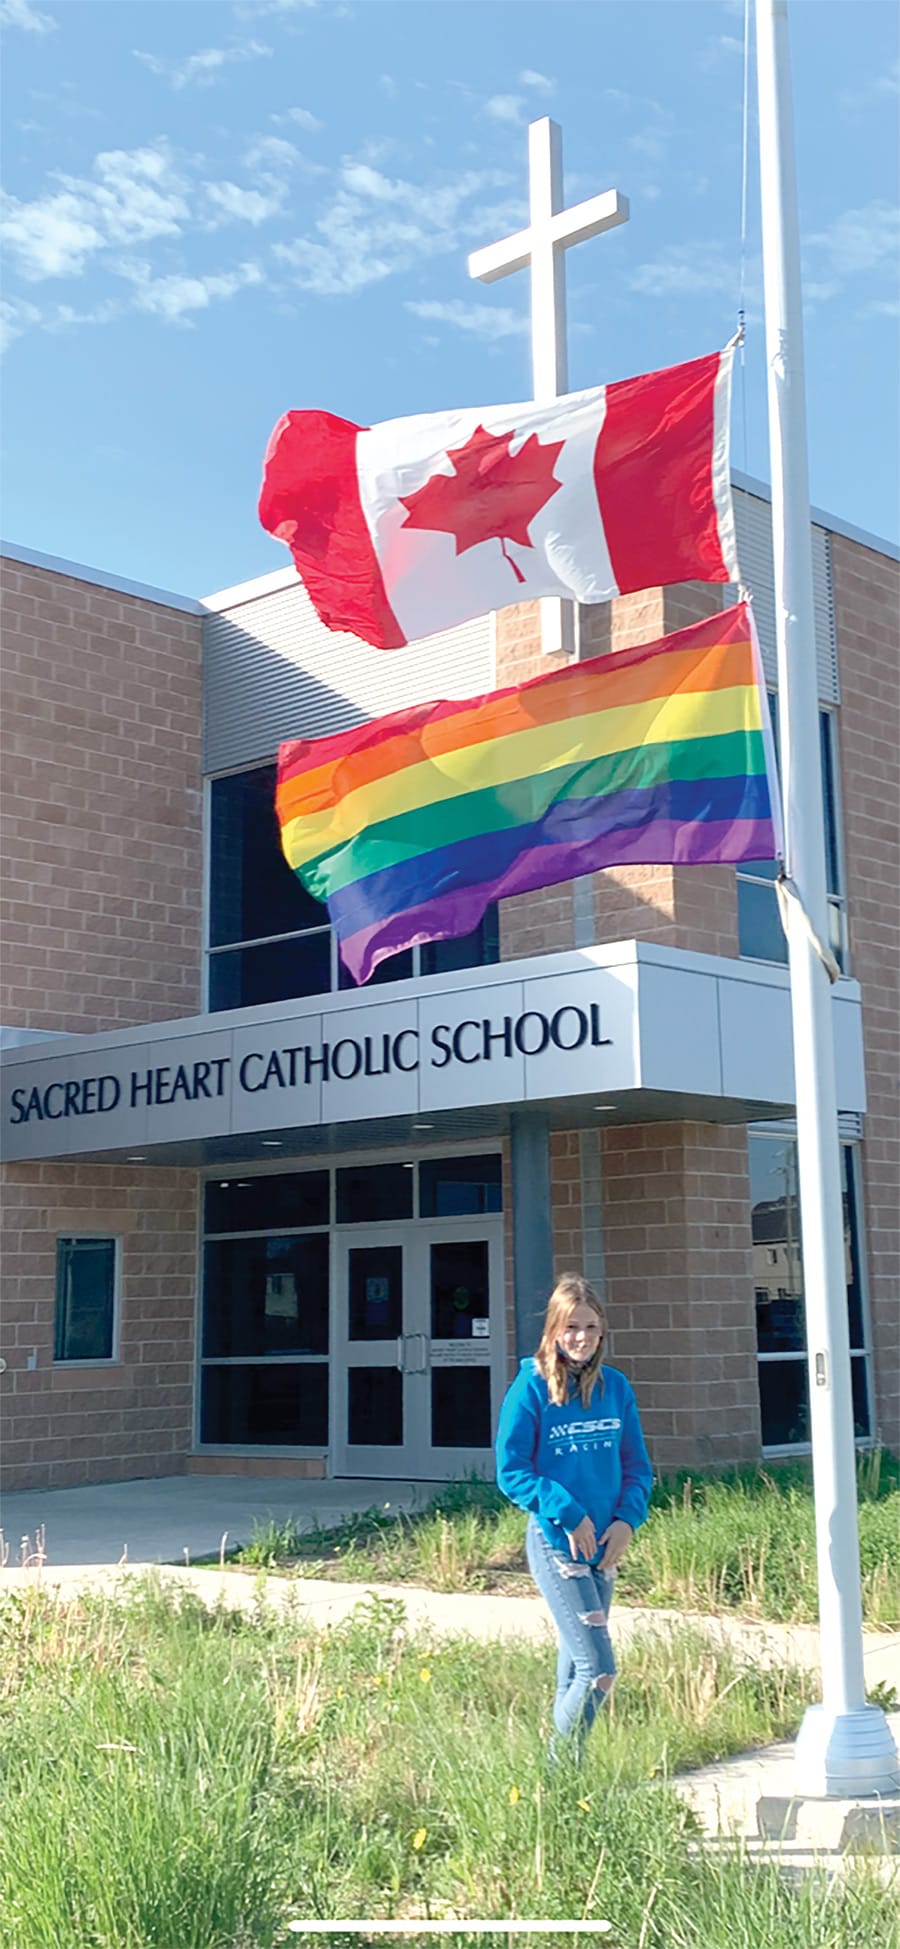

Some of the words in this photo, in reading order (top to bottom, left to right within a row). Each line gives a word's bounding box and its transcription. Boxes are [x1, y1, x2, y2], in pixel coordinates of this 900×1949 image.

[10, 1075, 121, 1124] SACRED
[130, 1058, 231, 1106] HEART
[239, 1026, 419, 1092] CATHOLIC
[430, 1003, 612, 1067] SCHOOL
[555, 1440, 612, 1455] RACIN
